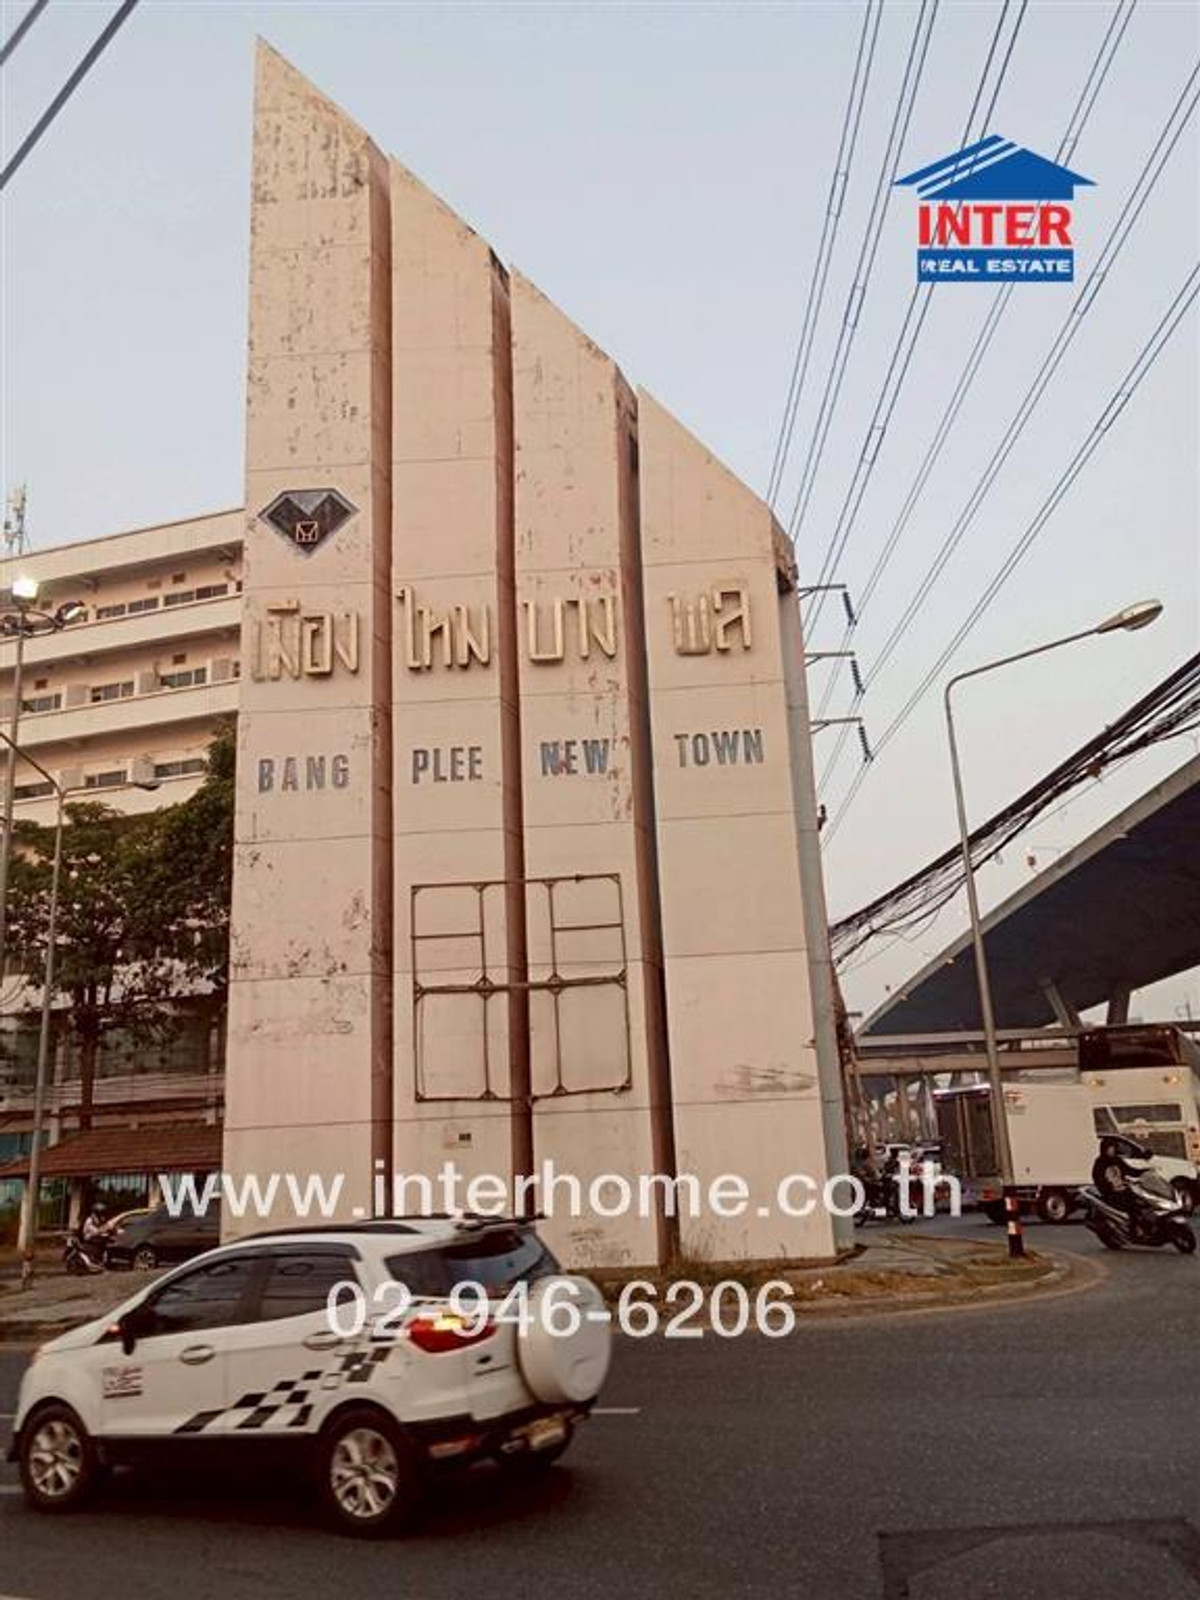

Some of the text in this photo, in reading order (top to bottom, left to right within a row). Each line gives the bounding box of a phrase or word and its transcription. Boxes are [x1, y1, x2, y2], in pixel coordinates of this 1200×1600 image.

[258, 729, 764, 793] BANG PLEE NEW TOWN
